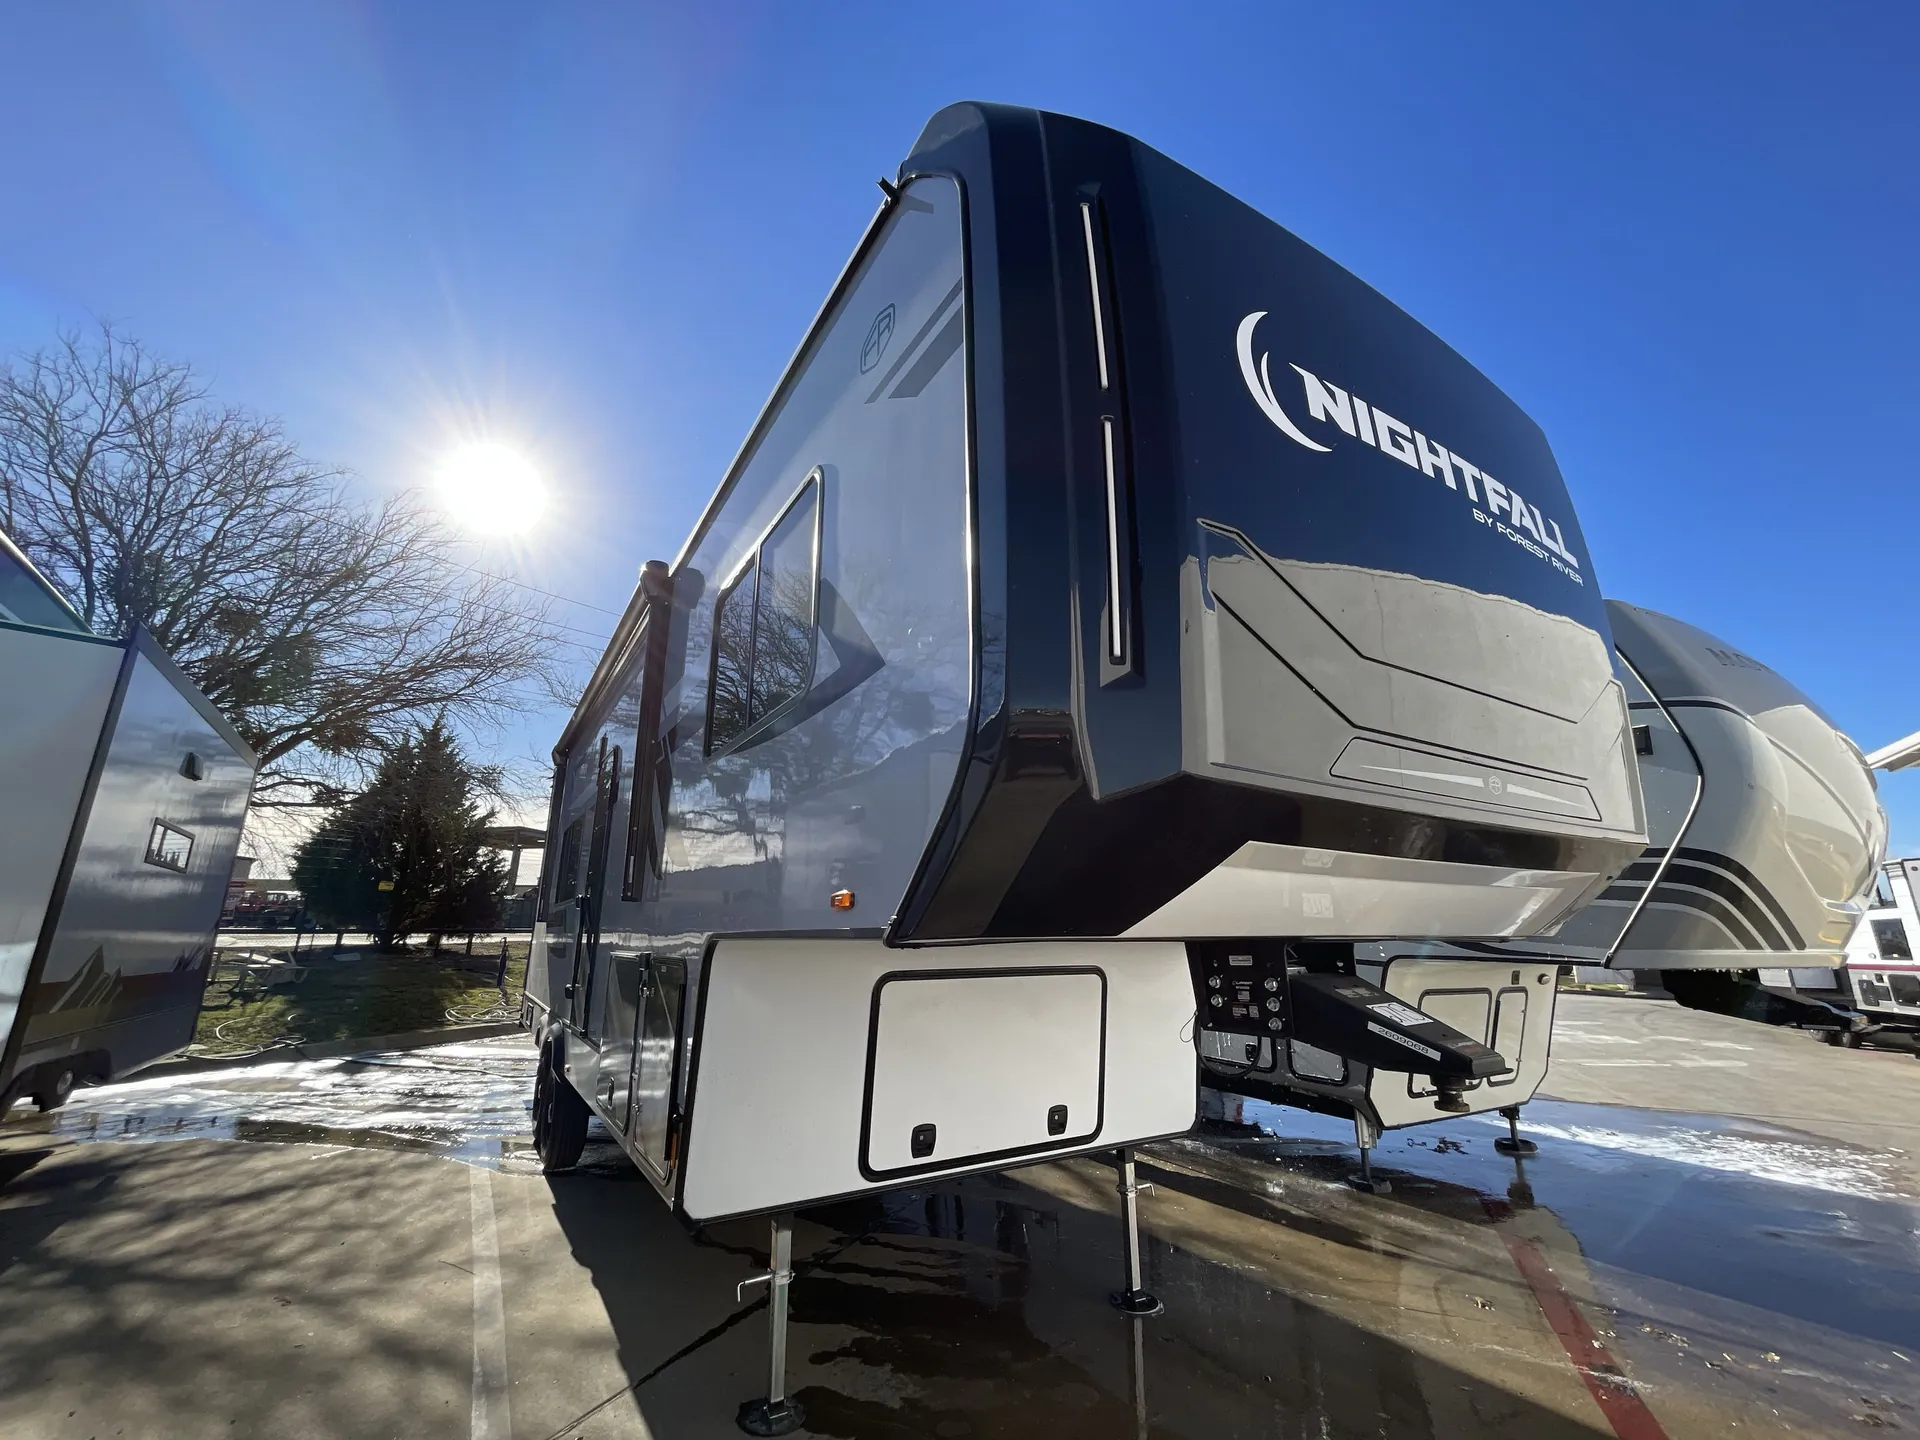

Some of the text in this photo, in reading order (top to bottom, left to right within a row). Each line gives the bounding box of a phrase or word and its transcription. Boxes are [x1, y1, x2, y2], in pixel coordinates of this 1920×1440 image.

[1289, 362, 1579, 569] NIGHTFALL
[1472, 507, 1584, 587] BY FOREST RIVER
[1378, 1027, 1428, 1054] 2609068
